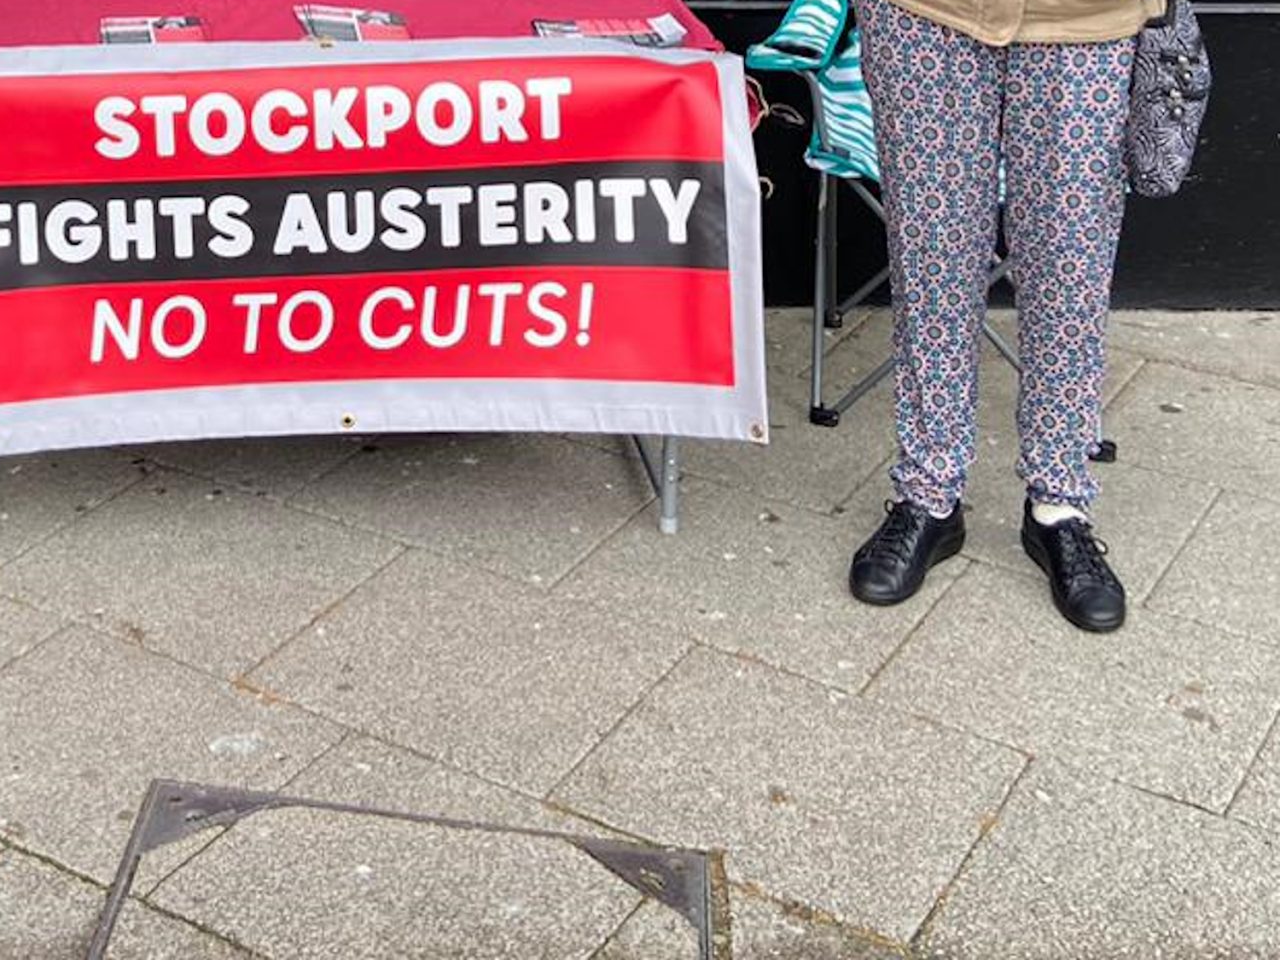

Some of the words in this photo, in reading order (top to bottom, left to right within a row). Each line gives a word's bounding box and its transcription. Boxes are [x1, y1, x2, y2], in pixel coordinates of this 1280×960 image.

[95, 77, 572, 159] STOCKPORT
[273, 178, 701, 255] AUSTERITY
[90, 295, 207, 363] NO
[233, 290, 334, 354] TO
[359, 282, 594, 350] CUTS!
